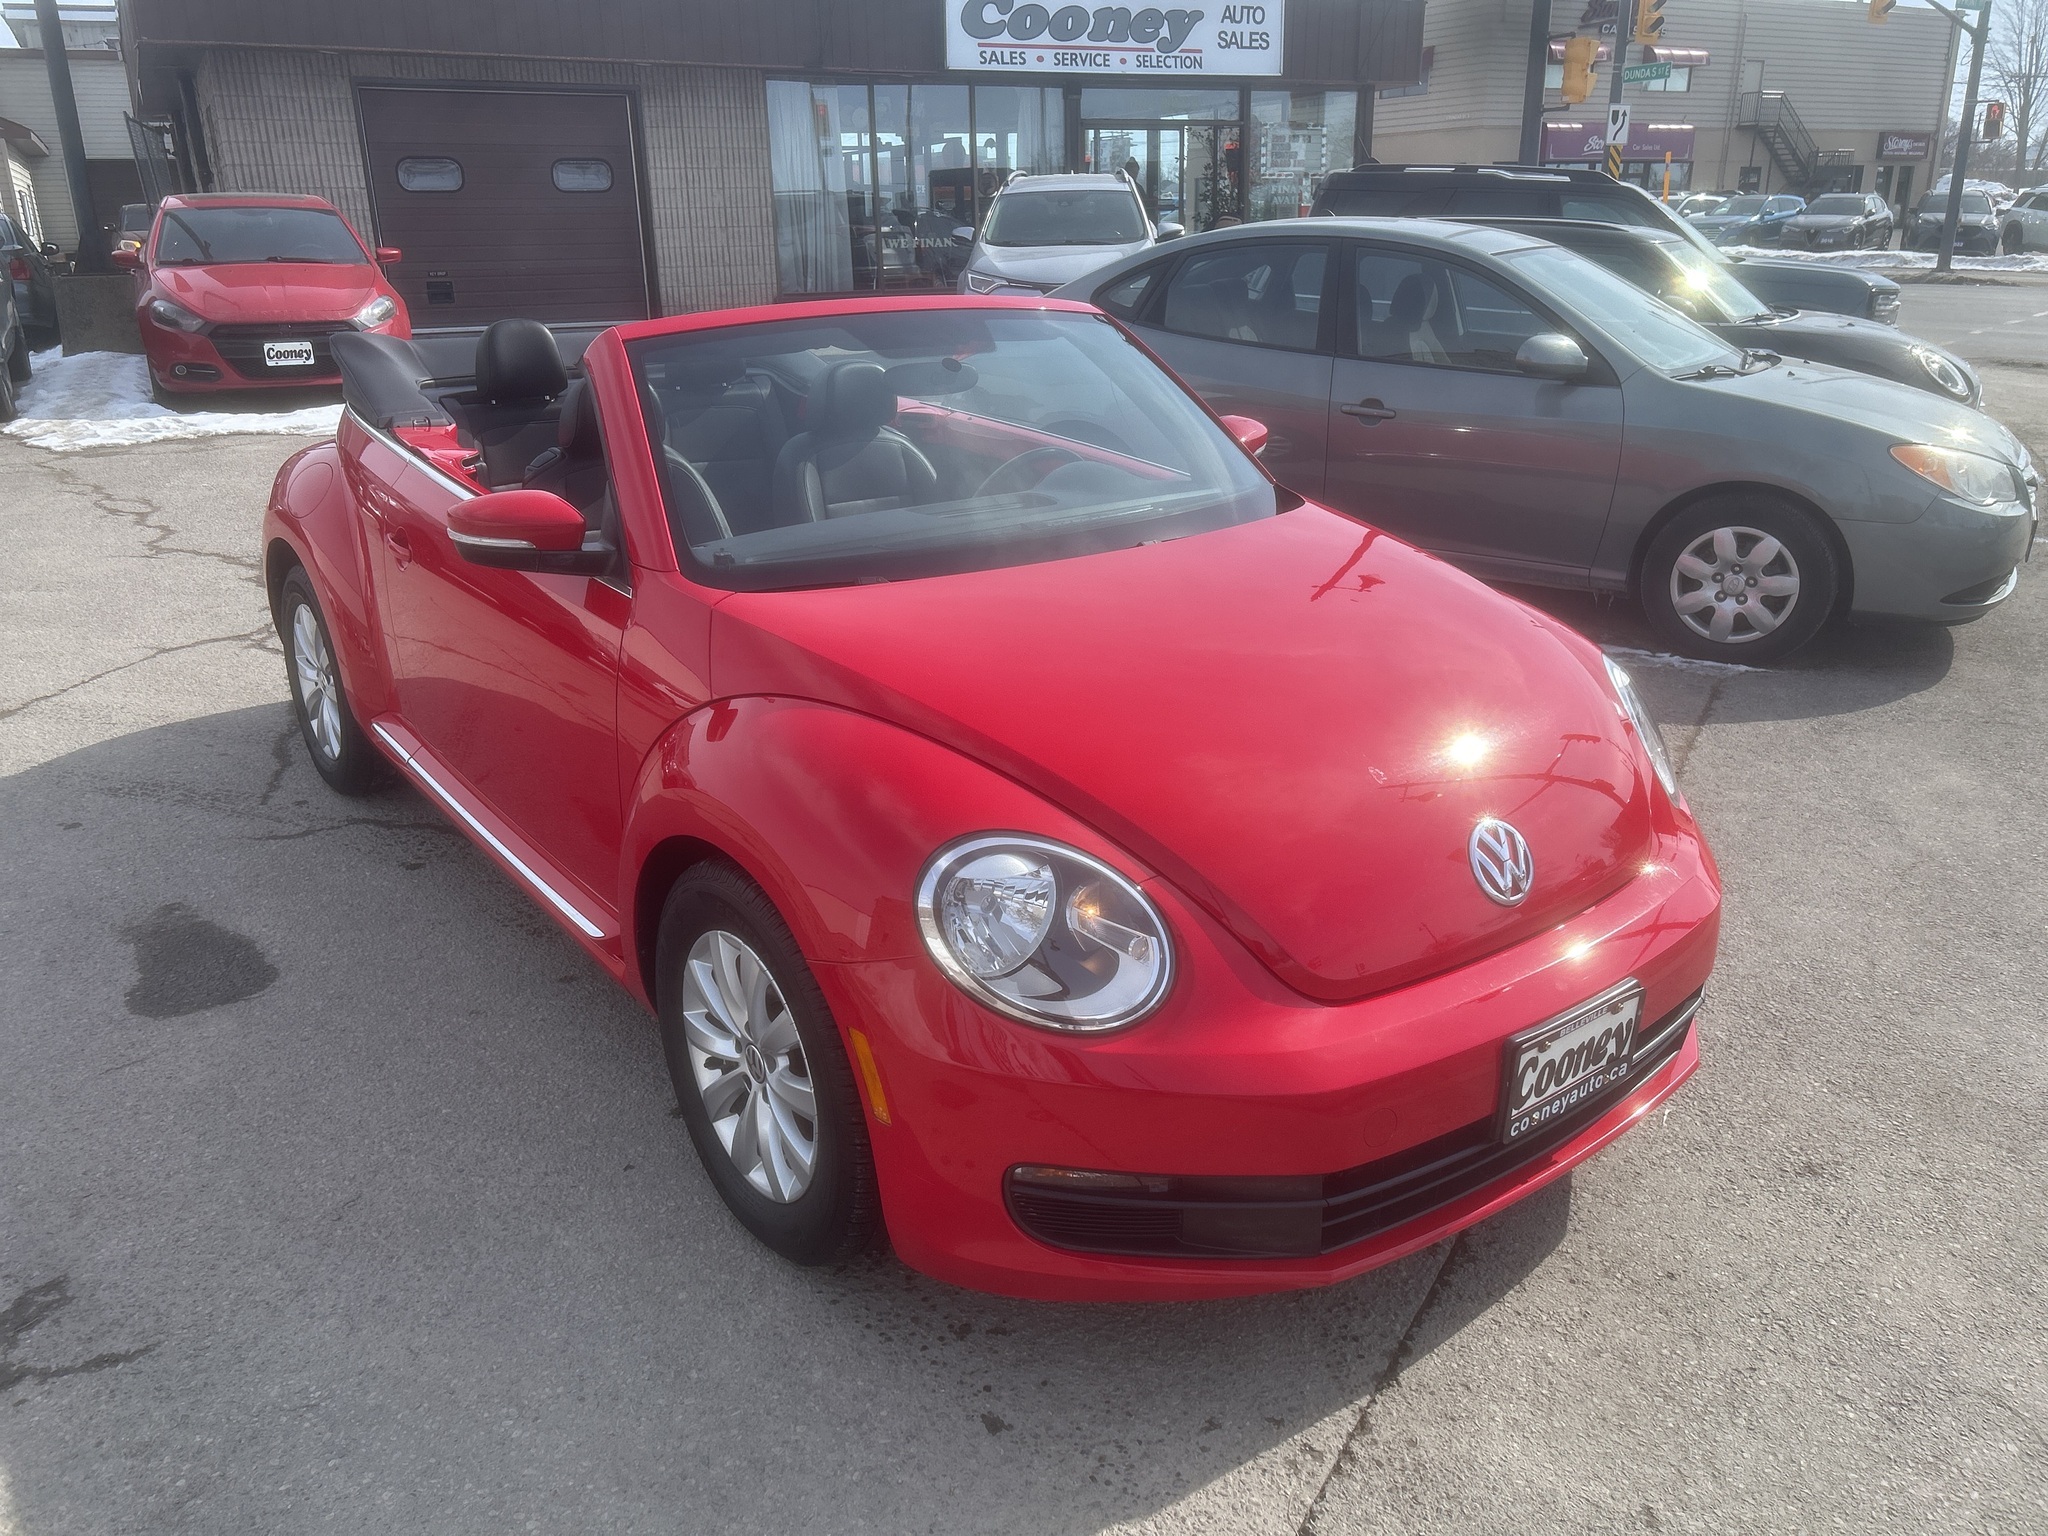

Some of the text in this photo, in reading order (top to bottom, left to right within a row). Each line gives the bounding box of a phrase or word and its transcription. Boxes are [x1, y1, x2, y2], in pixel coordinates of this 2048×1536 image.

[1221, 5, 1265, 25] AUTO
[961, 0, 1205, 53] Cooney
[1601, 24, 1617, 34] CA
[1217, 31, 1270, 50] SALES
[979, 51, 1203, 70] SALES SERVICE SELECTION
[1624, 66, 1657, 80] DUNDAS
[1665, 65, 1670, 76] E
[888, 238, 909, 248] WE
[266, 347, 312, 361] Cooney
[1559, 1007, 1608, 1038] BELLEVILLE
[1513, 1018, 1634, 1111] Cooney
[1510, 1061, 1629, 1137] coneyautoca
